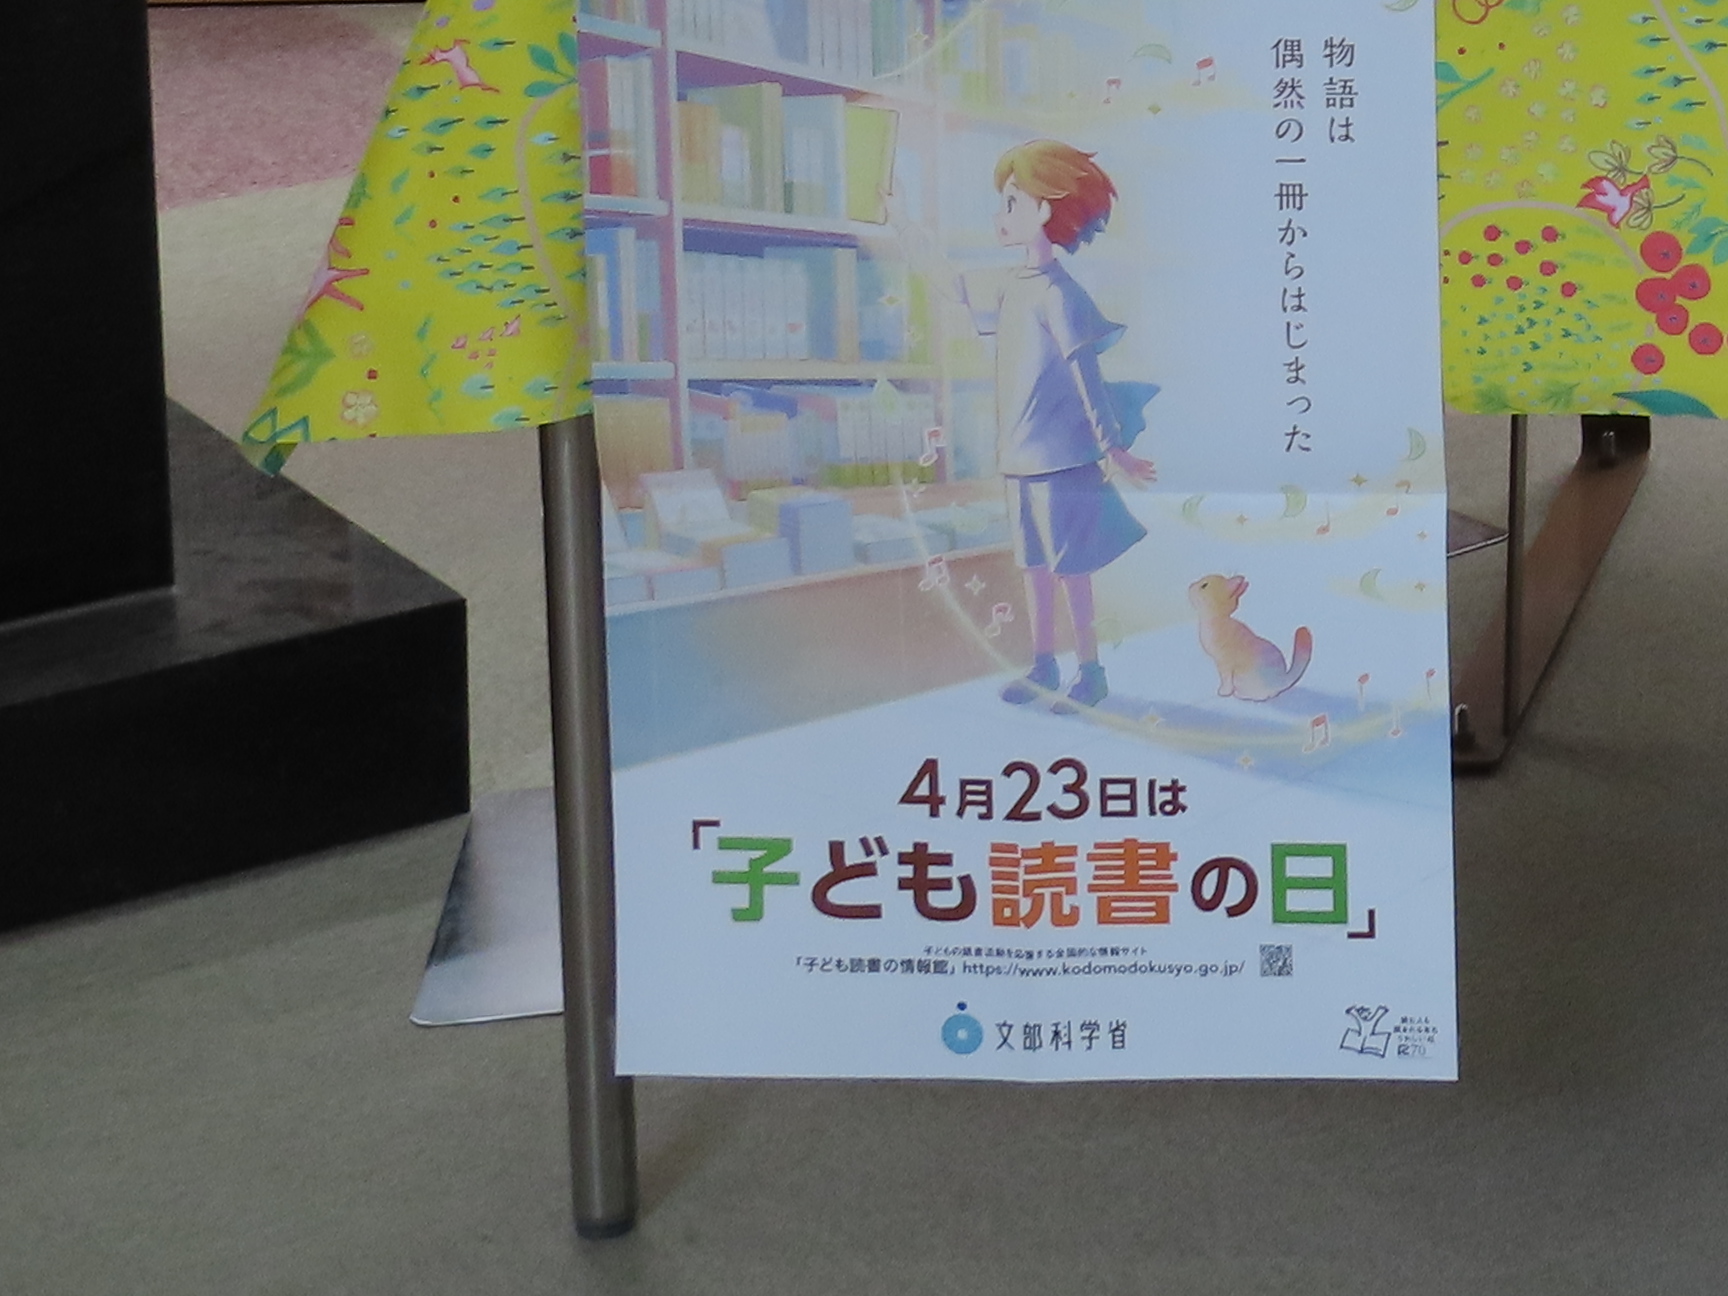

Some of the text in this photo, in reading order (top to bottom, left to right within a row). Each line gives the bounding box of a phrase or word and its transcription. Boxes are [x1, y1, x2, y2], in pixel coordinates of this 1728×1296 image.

[1321, 35, 1359, 145] 物語は
[1269, 37, 1314, 454] 偶然の一冊からはじまった
[898, 757, 1189, 824] 4月23日は
[690, 819, 1377, 939] 「子ども読書の日」
[962, 958, 1246, 979] https://www.kodomodokusyo.go.jp/
[994, 1017, 1128, 1053] 文部科学省
